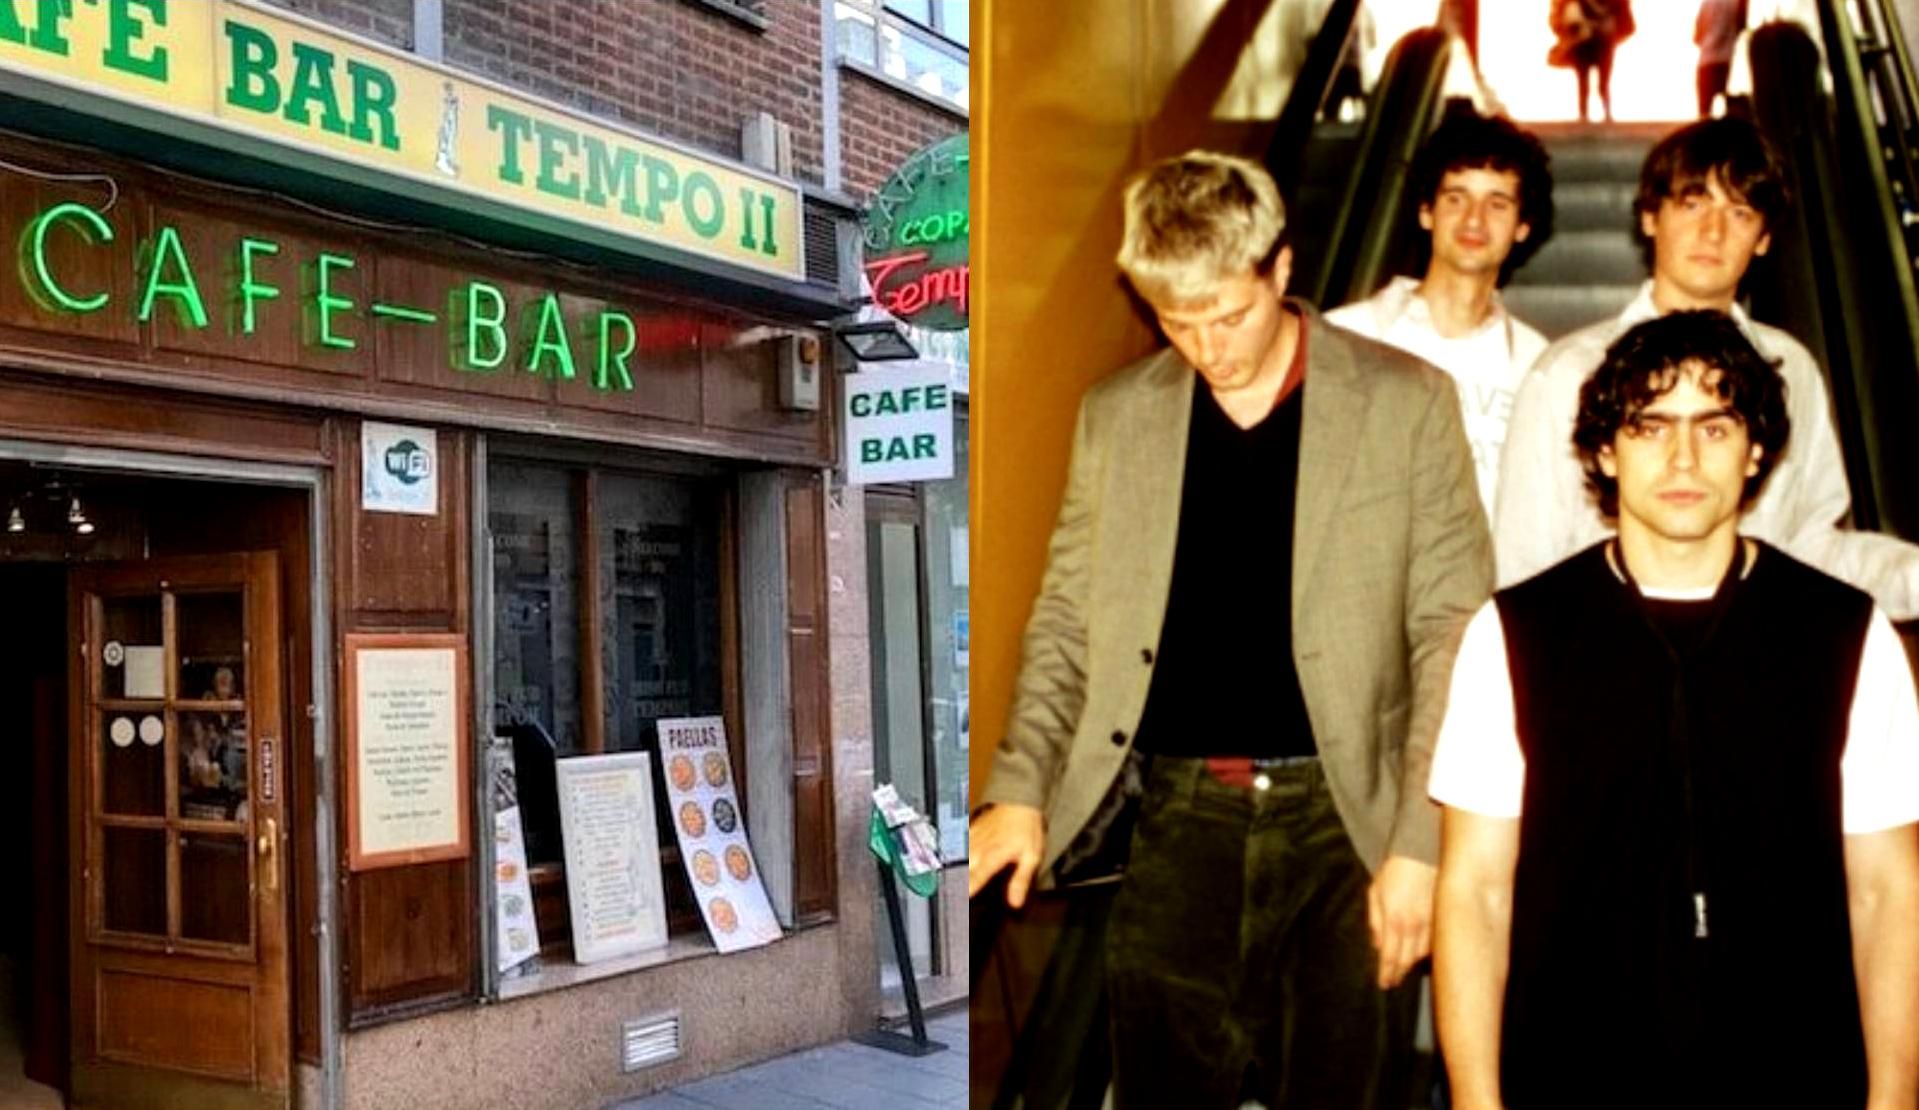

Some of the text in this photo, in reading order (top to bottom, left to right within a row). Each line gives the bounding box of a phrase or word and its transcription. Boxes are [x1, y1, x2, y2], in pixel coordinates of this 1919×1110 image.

[225, 20, 400, 151] BAR
[487, 104, 725, 240] TEMPO
[740, 187, 777, 257] II
[901, 210, 968, 245] COP
[850, 384, 946, 417] CAFE
[861, 434, 937, 463] BAR
[669, 726, 717, 749] PAELLAS
